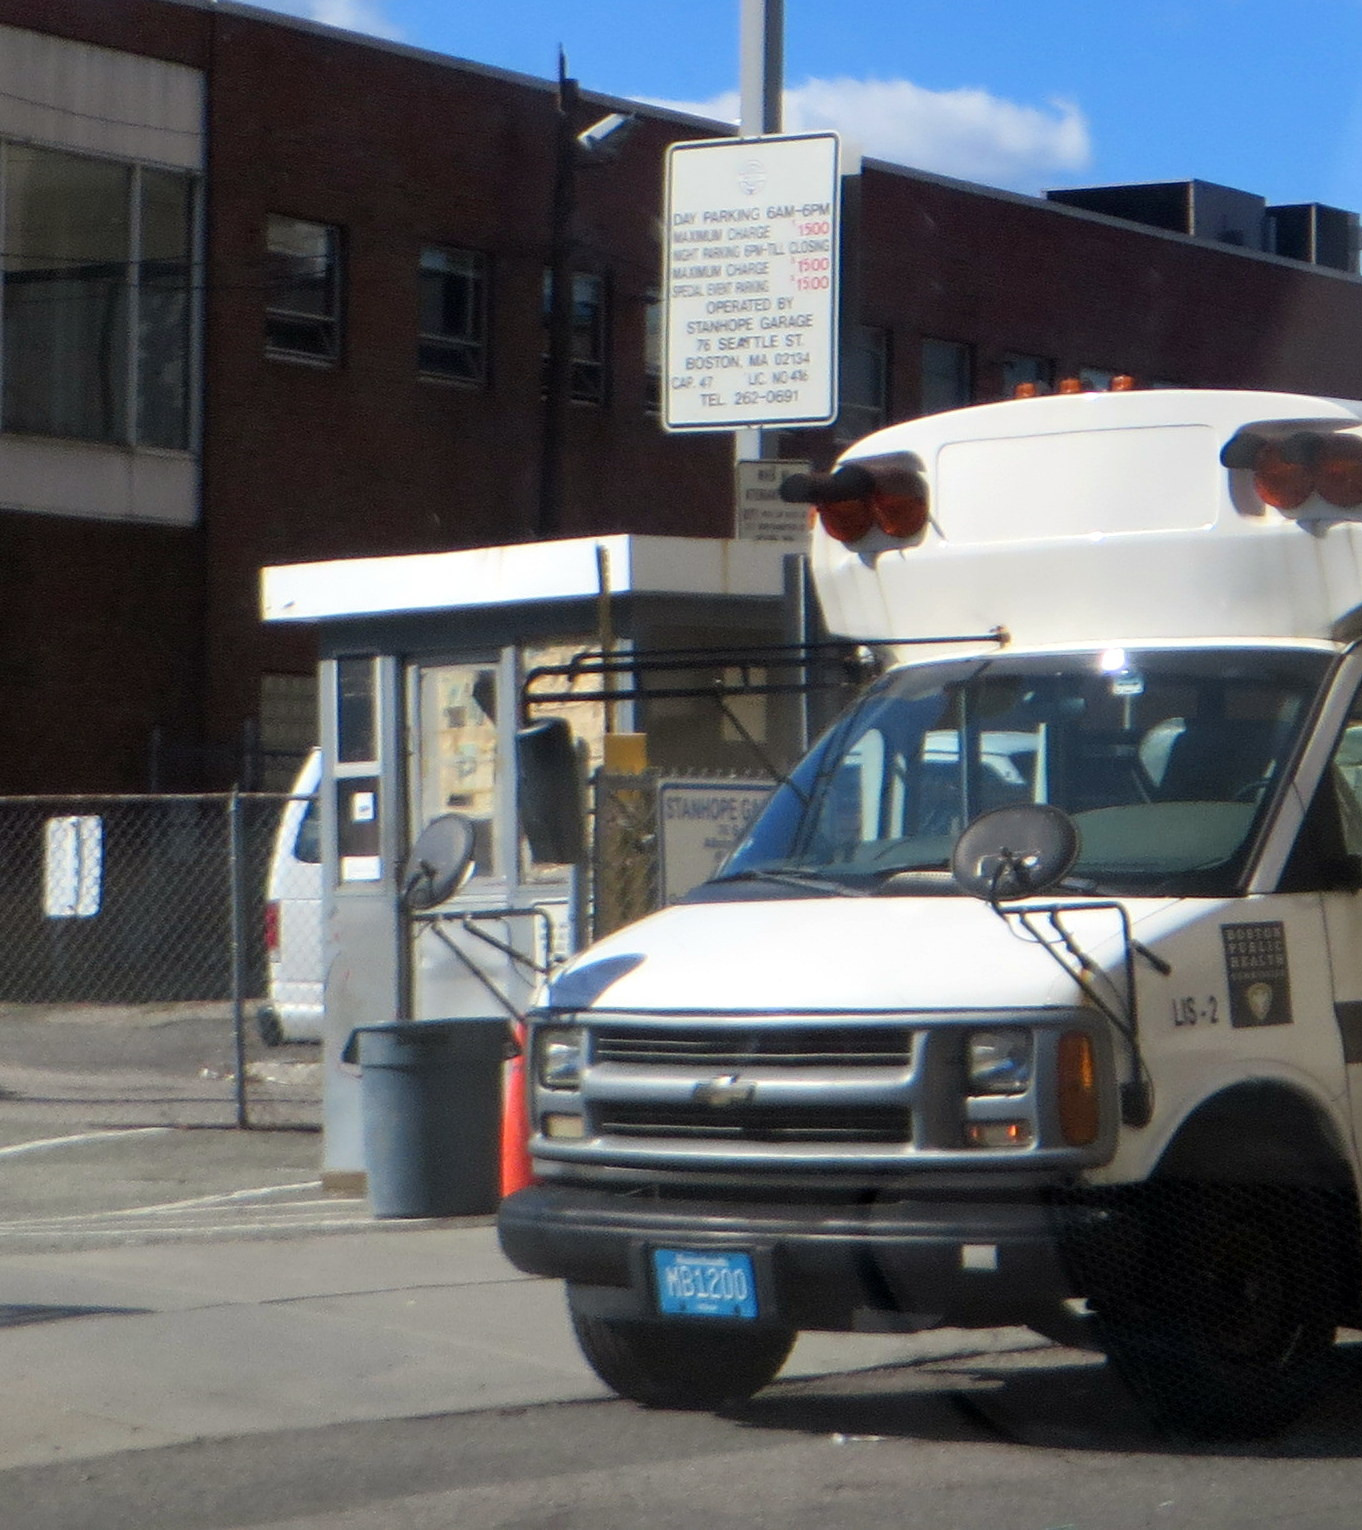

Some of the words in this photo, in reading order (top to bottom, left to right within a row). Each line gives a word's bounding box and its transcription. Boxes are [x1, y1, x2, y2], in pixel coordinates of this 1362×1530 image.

[673, 212, 697, 226] DAY
[703, 207, 760, 223] PARKING
[766, 203, 830, 220] 6AM-6PM
[673, 229, 723, 244] MAXIMUM
[728, 225, 771, 241] CHARGE
[703, 245, 740, 260] PARKING
[788, 239, 830, 254] CLOSING
[672, 265, 722, 280] MAXIMUM
[726, 262, 769, 276] CHARGE
[672, 283, 704, 298] SPECIAL
[706, 281, 733, 296] EVENT
[735, 280, 769, 294] PARKING
[706, 298, 772, 315] OPERATED
[777, 296, 794, 310] BY
[686, 317, 754, 335] STANHOPE
[760, 314, 814, 330] GARAGE
[697, 338, 711, 352] 76
[718, 334, 779, 351] SEATTLE
[748, 354, 768, 367] MA
[775, 352, 810, 366] 02134
[699, 376, 714, 389] 47
[734, 389, 800, 406] 262-0691
[665, 797, 737, 820] STANHOPE
[1224, 926, 1282, 940] BOSTON
[1228, 940, 1282, 954] PUBLIC
[1230, 954, 1284, 968] HEALTH
[1171, 995, 1219, 1026] LIS-2
[665, 1265, 748, 1300] MB1200
